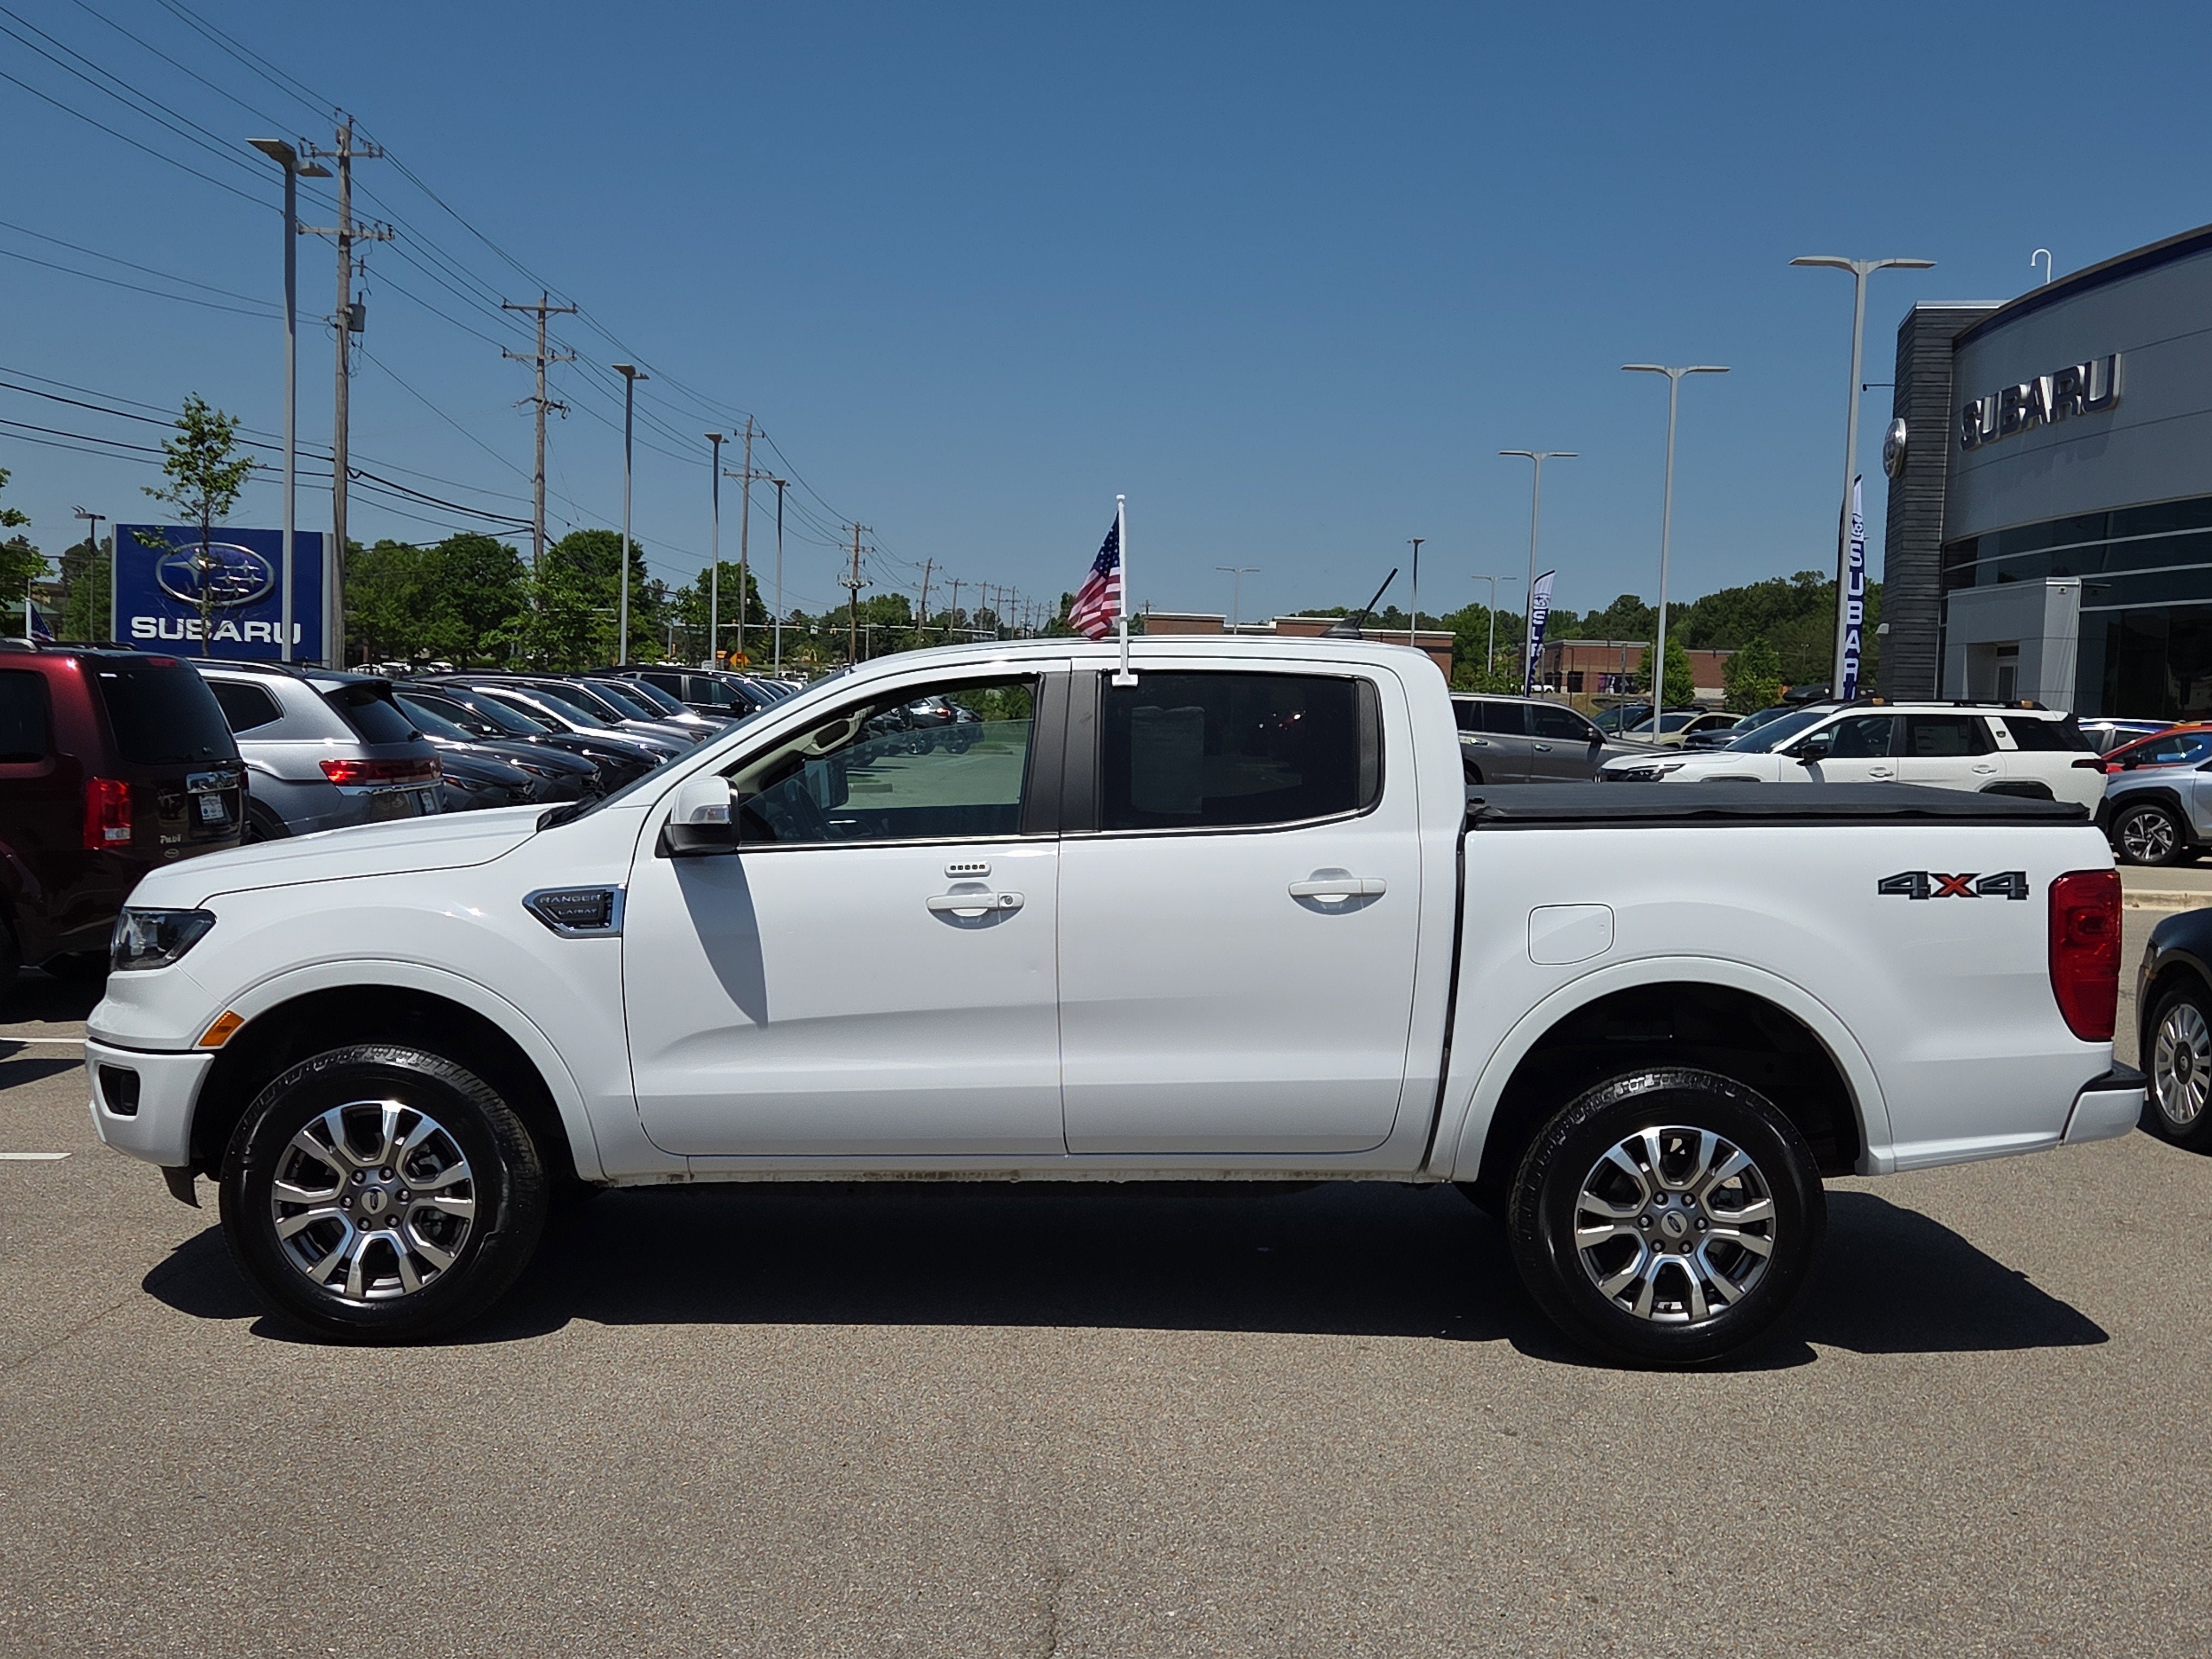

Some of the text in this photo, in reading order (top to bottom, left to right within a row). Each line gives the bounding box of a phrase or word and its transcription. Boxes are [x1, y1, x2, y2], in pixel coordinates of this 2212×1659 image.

[1960, 353, 2122, 452] SUBARU
[131, 616, 301, 645] SUBARU
[540, 894, 601, 903] RANGER
